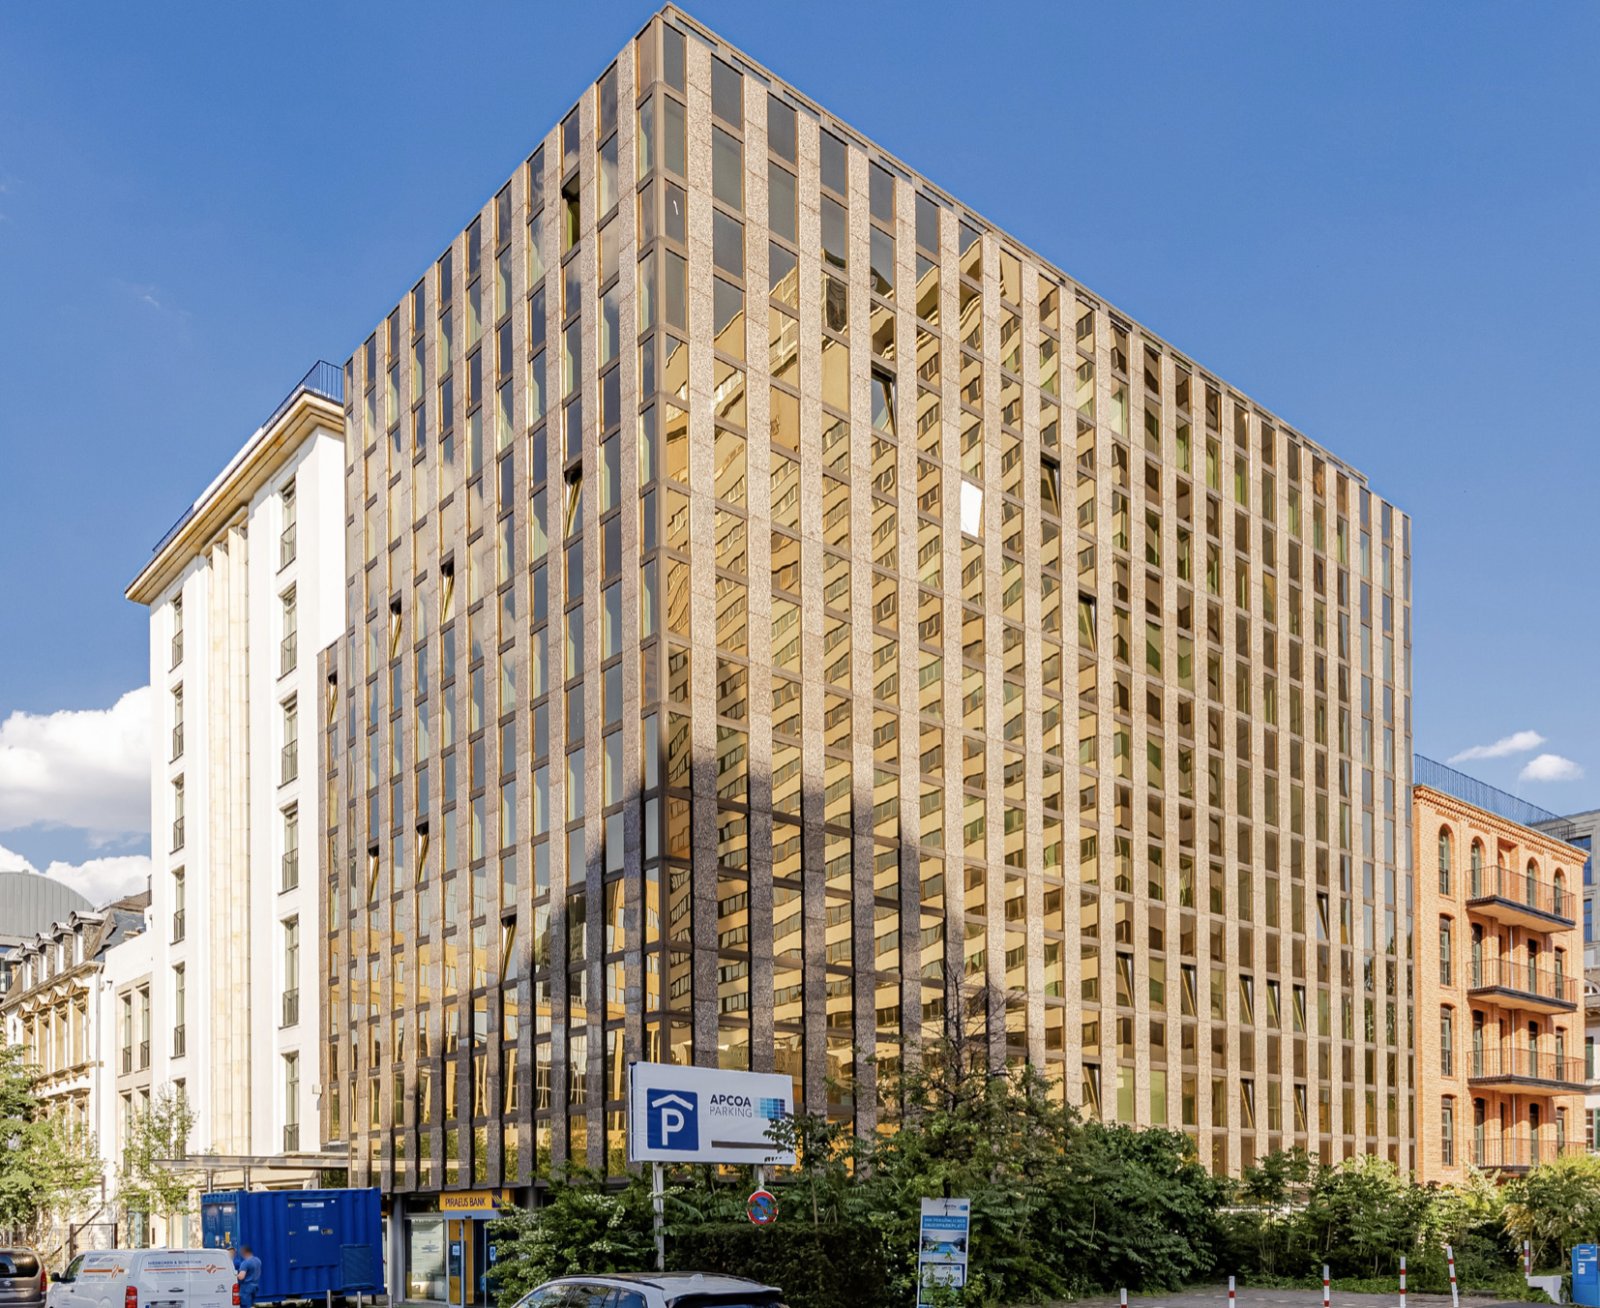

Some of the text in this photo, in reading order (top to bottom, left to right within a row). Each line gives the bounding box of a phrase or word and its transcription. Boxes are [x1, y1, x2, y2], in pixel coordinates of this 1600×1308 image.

[710, 1094, 752, 1107] APCOA
[709, 1106, 753, 1118] PARKING
[661, 1108, 685, 1146] P
[445, 1196, 486, 1207] PIRAEUS BANK
